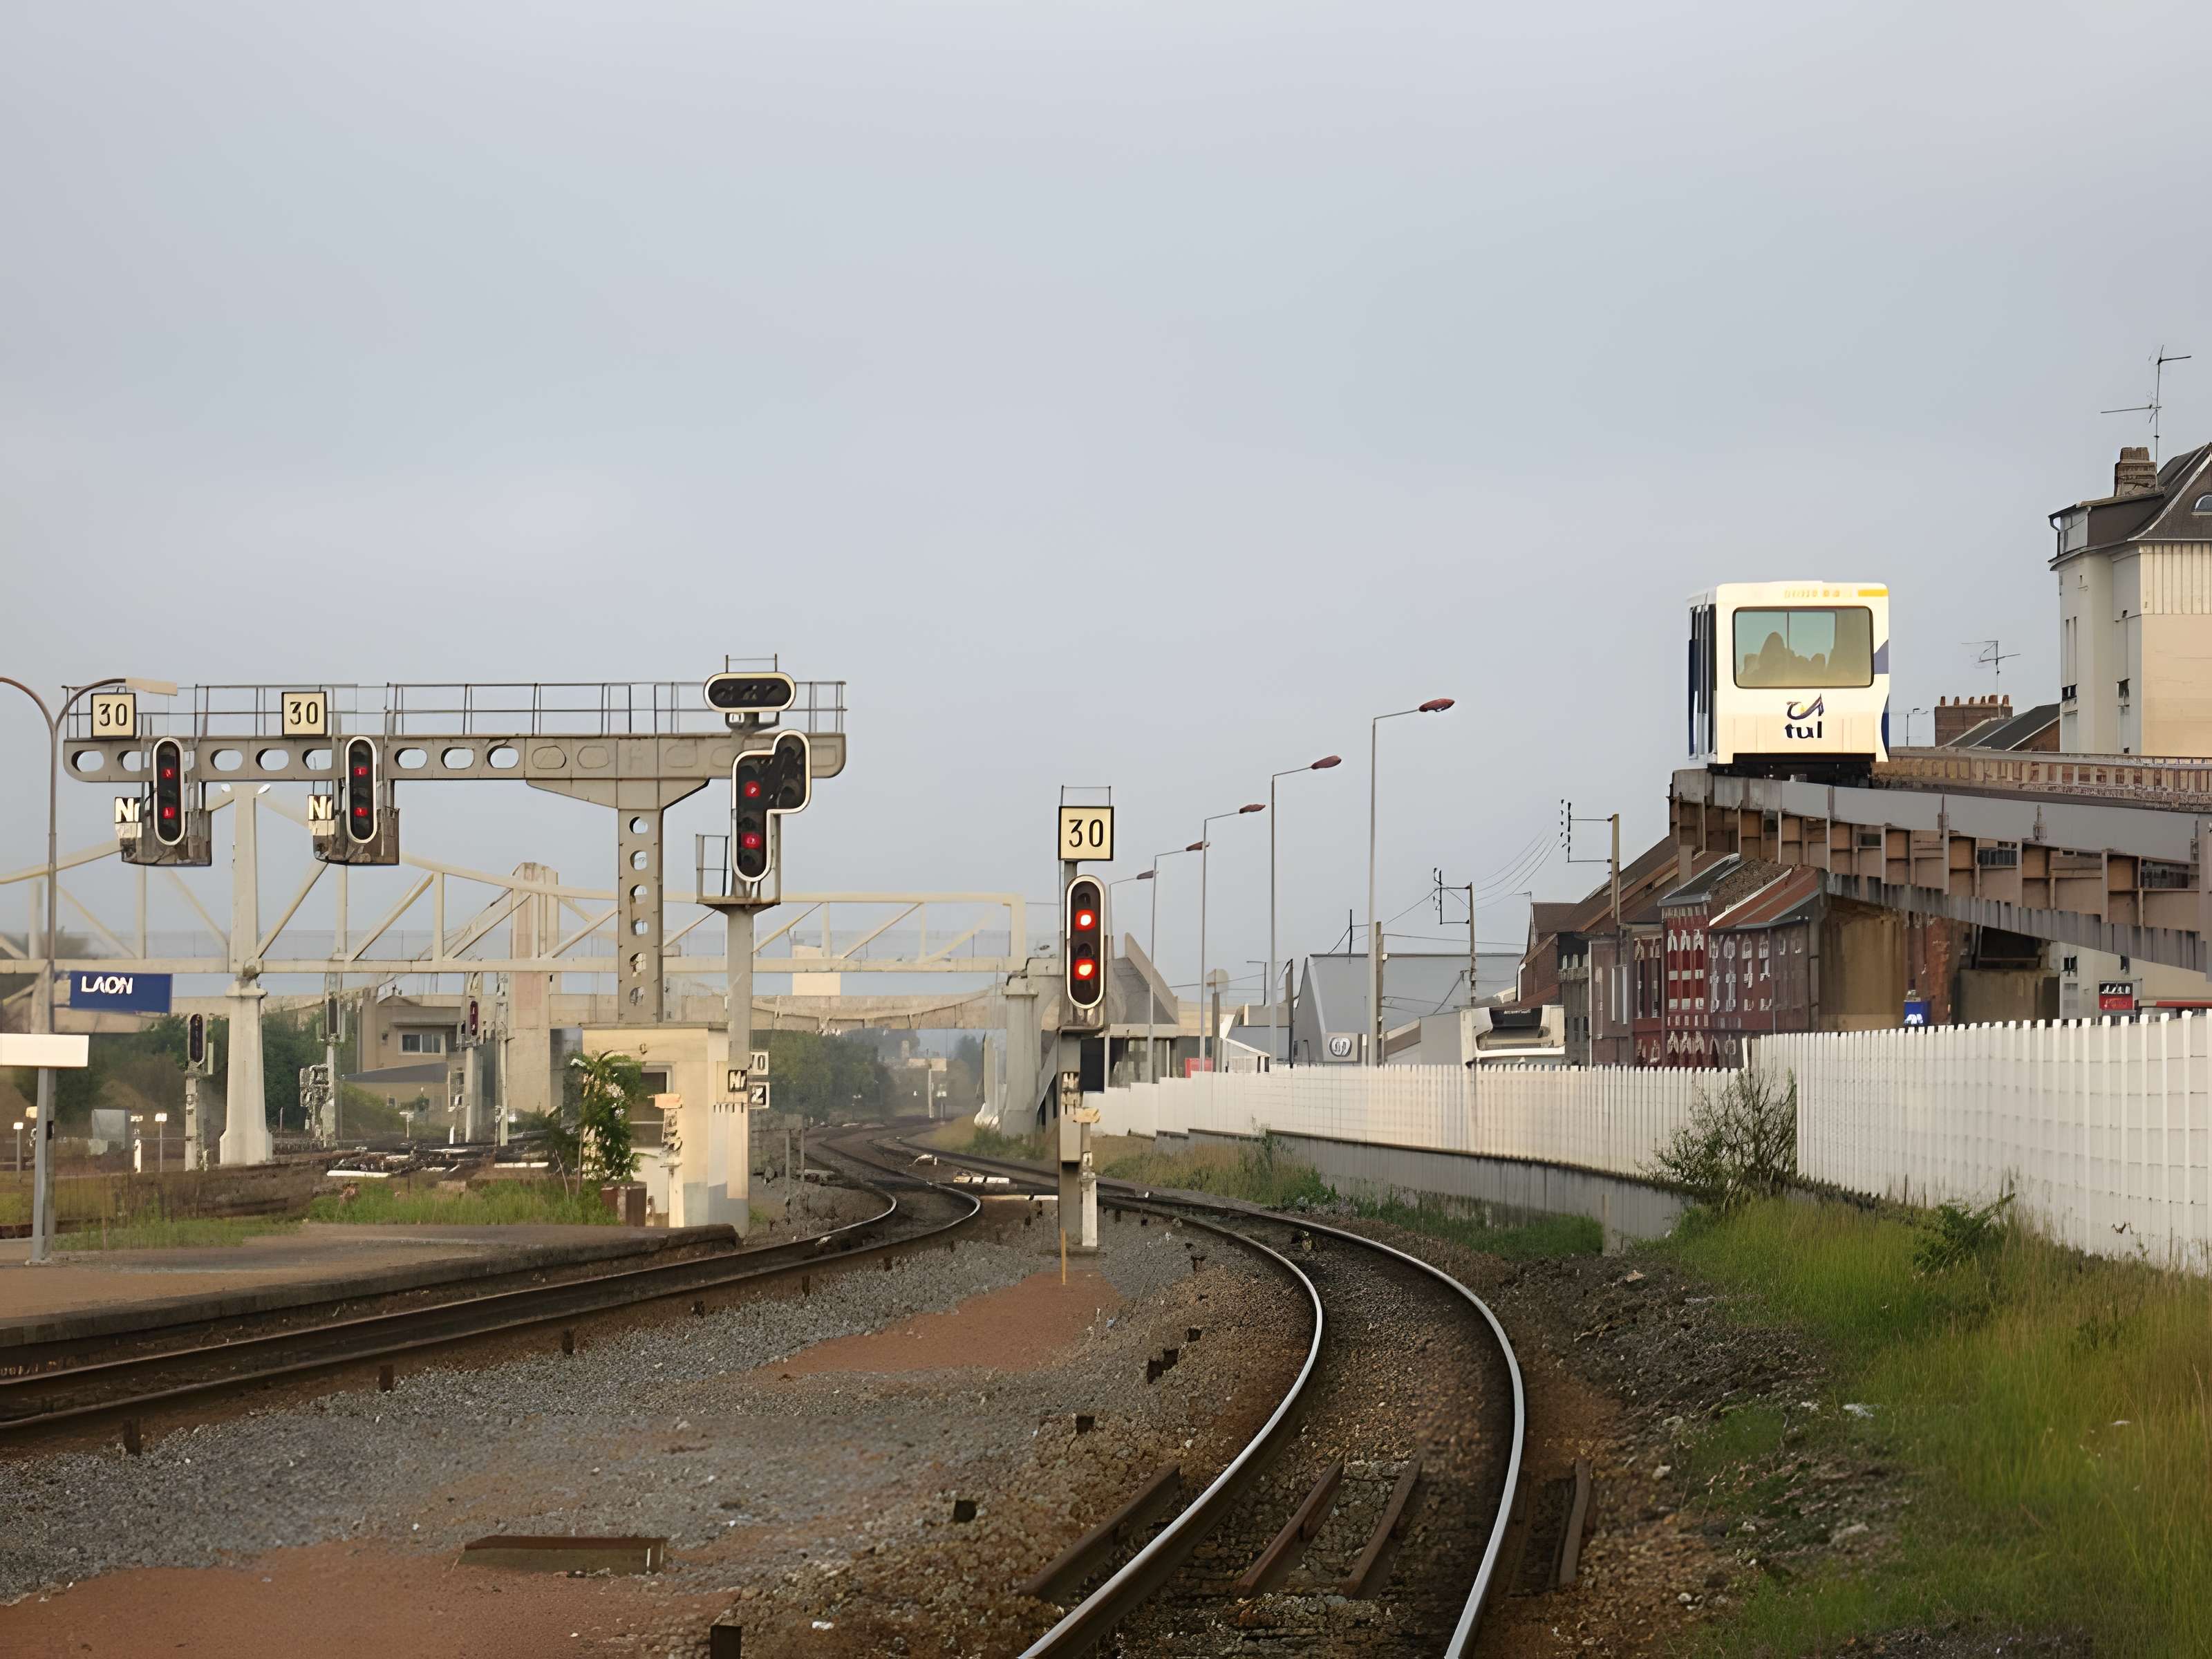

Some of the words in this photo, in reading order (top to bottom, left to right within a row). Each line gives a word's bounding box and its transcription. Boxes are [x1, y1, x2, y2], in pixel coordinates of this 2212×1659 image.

[99, 703, 127, 727] 30
[290, 701, 318, 724] 30
[1785, 721, 1822, 738] tul
[1068, 819, 1104, 847] 30
[81, 975, 133, 994] LAON
